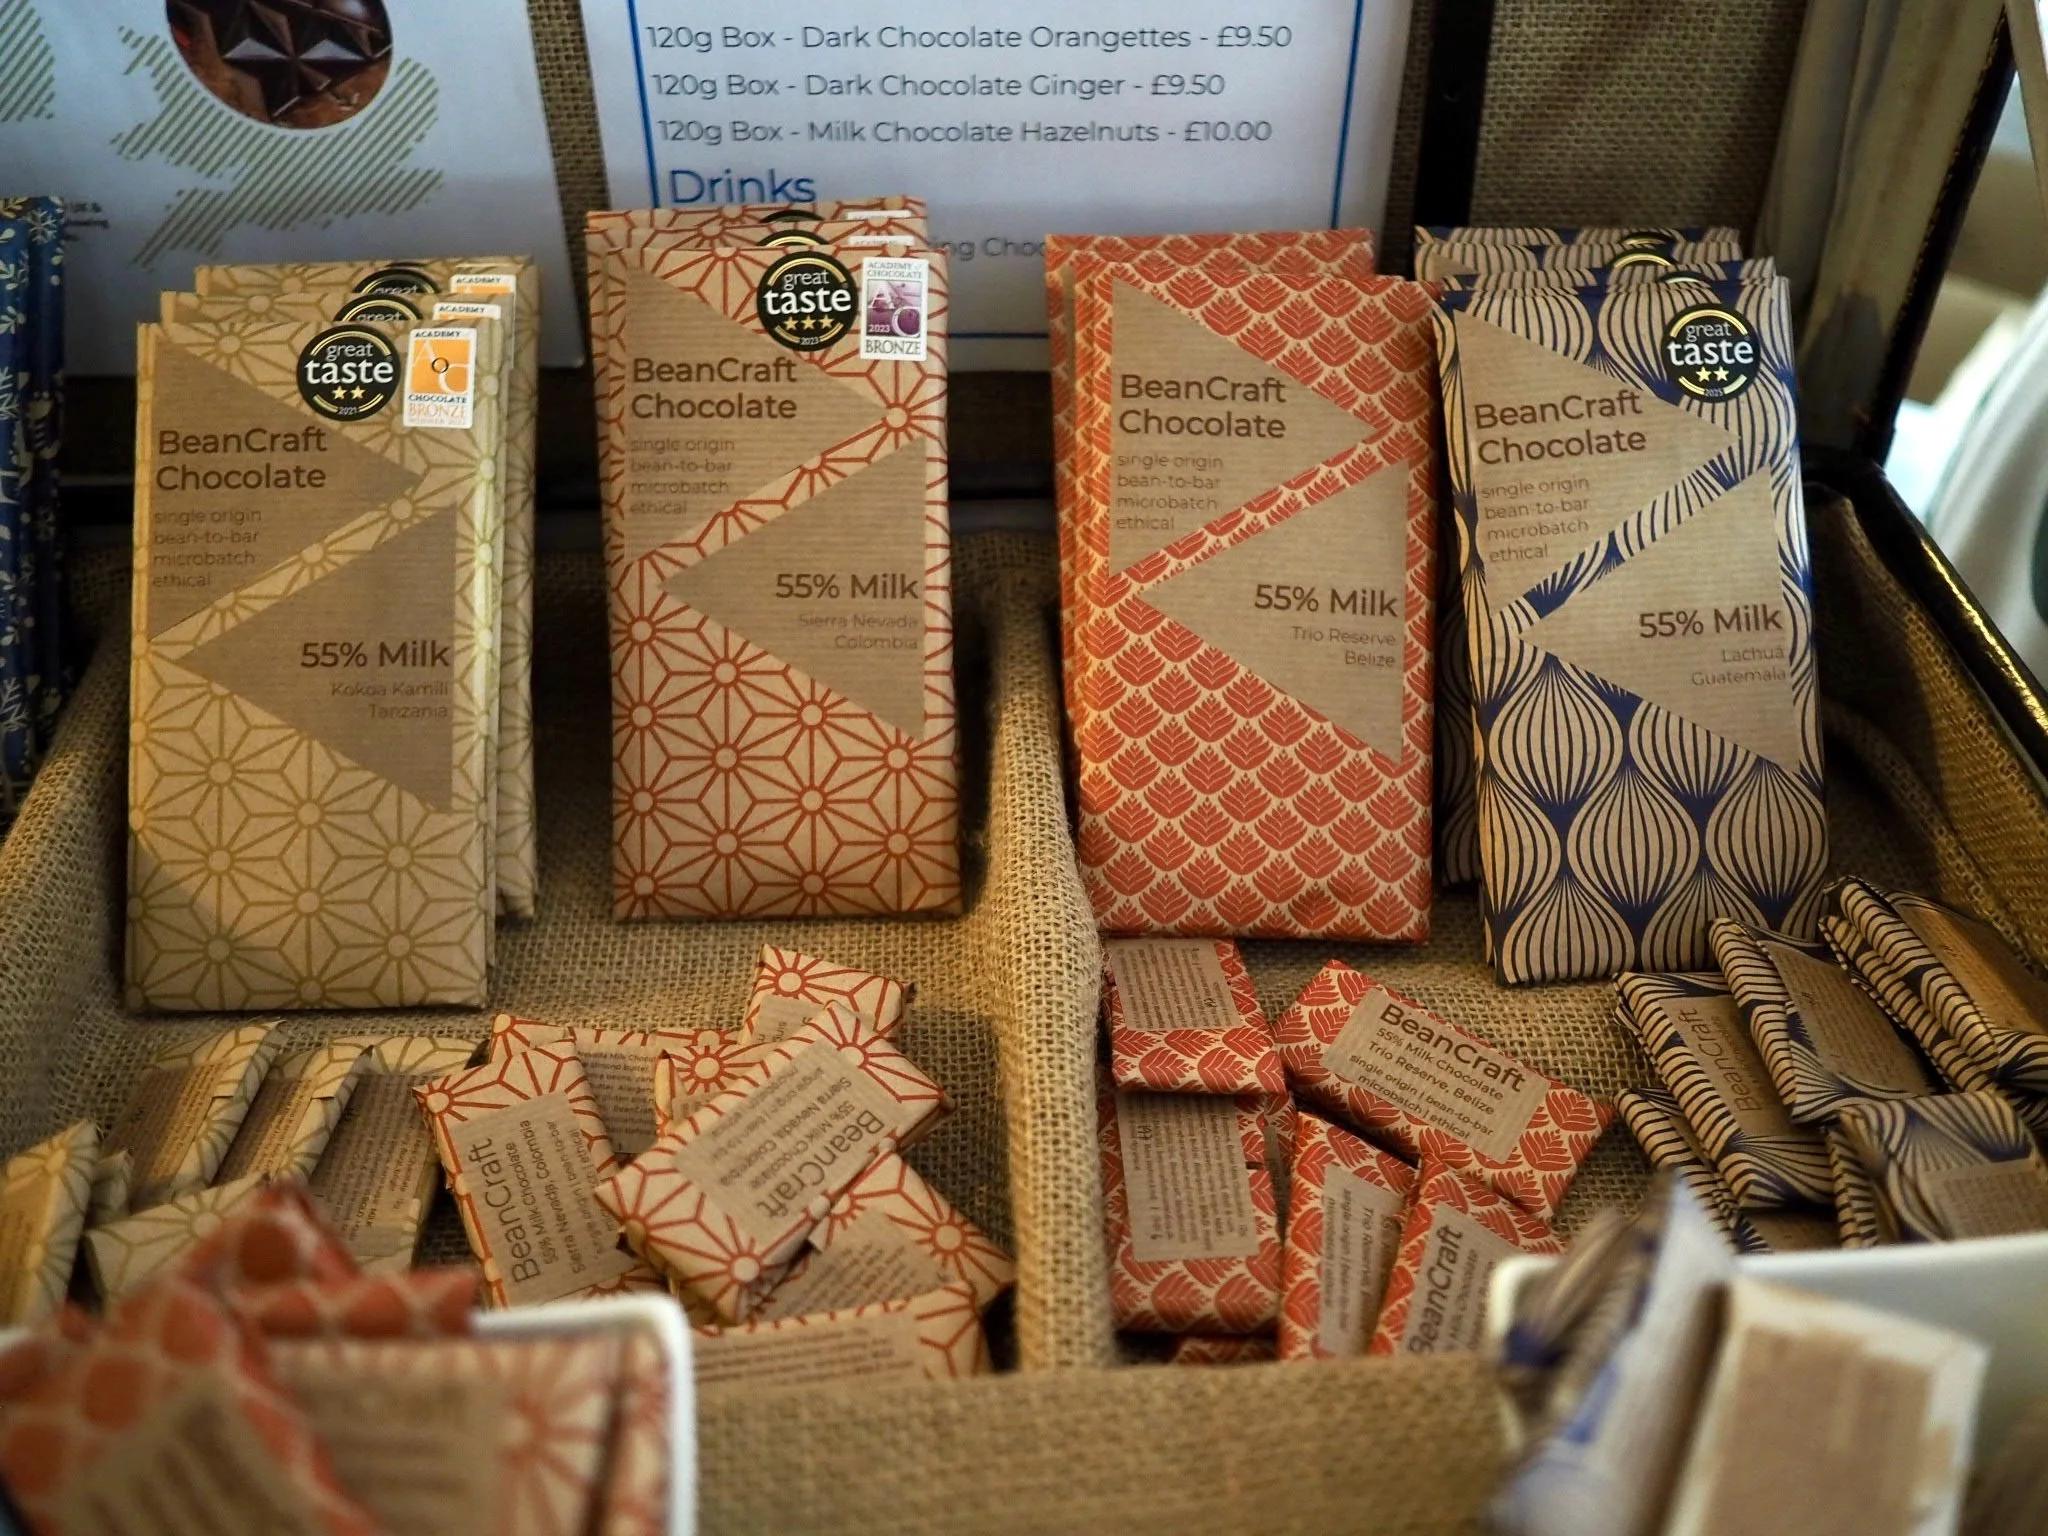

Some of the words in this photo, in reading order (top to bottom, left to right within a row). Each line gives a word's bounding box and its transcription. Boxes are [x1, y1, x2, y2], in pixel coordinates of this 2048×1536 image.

[646, 26, 712, 52] 120g
[722, 26, 776, 48] Box
[802, 26, 871, 48] Dark
[877, 25, 1021, 48] Chocolate
[1030, 26, 1191, 52] Orangettes
[1216, 25, 1293, 49] £9.50
[652, 74, 718, 100] 120g
[727, 74, 780, 96] Box
[806, 74, 872, 96] Dark
[879, 74, 1021, 97] Chocolate
[1029, 74, 1125, 101] Ginger
[1151, 74, 1226, 96] £9.50
[659, 120, 722, 146] 120g
[731, 120, 783, 142] Box
[808, 120, 866, 142] Milk
[872, 120, 1013, 143] Chocolate
[1021, 120, 1160, 143] Hazelnuts
[1184, 120, 1272, 142] £10.00
[669, 167, 817, 204] Drinks
[868, 262, 912, 270] ACADEMY
[784, 270, 830, 291] great
[763, 288, 851, 315] taste
[414, 330, 461, 339] ACADEMY
[868, 323, 891, 333] 2023
[1686, 322, 1731, 343] great
[326, 342, 373, 359] great
[865, 339, 922, 355] BRONZE
[1667, 339, 1753, 366] taste
[304, 357, 394, 386] taste
[632, 357, 797, 384] BeanCraft
[408, 394, 468, 404] CHOCOLATE
[1121, 374, 1287, 403] BeanCraft
[631, 392, 797, 420] Chocolate
[1475, 390, 1643, 430] BeanCraft
[1119, 409, 1286, 439] Chocolate
[157, 427, 328, 457] BeanCraft
[630, 437, 680, 454] single
[685, 437, 735, 454] origin
[1478, 429, 1647, 466] Chocolate
[630, 458, 732, 474] bean-to-bar
[1118, 453, 1169, 470] single
[1174, 454, 1224, 471] origin
[156, 463, 326, 492] Chocolate
[630, 479, 729, 495] microbatch
[1117, 474, 1221, 490] bean-to-bar
[1481, 481, 1535, 500] single
[1538, 475, 1590, 496] origin
[154, 508, 206, 526] single
[209, 508, 262, 526] origin
[630, 500, 687, 516] ethical
[1117, 496, 1217, 511] microbatch
[1484, 498, 1589, 521] bean-to-bar
[1116, 516, 1175, 531] ethical
[1487, 518, 1589, 541] microbatch
[154, 529, 258, 546] bean-to-bar
[153, 550, 256, 567] microbatch
[1489, 543, 1548, 563] ethical
[152, 572, 211, 588] ethical
[775, 573, 840, 599] 55%
[851, 573, 919, 600] Milk
[1254, 583, 1319, 612] 55%
[1331, 587, 1398, 618] Milk
[854, 613, 918, 629] Nevada
[1639, 610, 1704, 639] 55%
[1714, 604, 1783, 634] Milk
[834, 635, 918, 650] Colombia
[1292, 625, 1324, 643] Trio
[1329, 627, 1396, 647] Reserve
[300, 641, 367, 668] 55%
[378, 640, 450, 668] Milk
[1345, 650, 1396, 668] Belize
[1692, 666, 1786, 687] Guatemala
[369, 703, 448, 719] Tanzania
[1379, 1002, 1528, 1093] BeanCraft
[1677, 1006, 1760, 1115] BeanCraft
[1375, 1026, 1404, 1047] 55%
[1404, 1041, 1434, 1064] Milk
[1434, 1058, 1504, 1101] Chocolate
[815, 1075, 851, 1105] Sierra
[1367, 1040, 1394, 1061] Trio
[1394, 1056, 1452, 1093] Reserve,
[1452, 1087, 1495, 1116] Belize
[1348, 1053, 1383, 1077] single
[1383, 1072, 1418, 1097] origin
[1424, 1095, 1494, 1136] bean-to-bar
[1357, 1074, 1423, 1114] microbatch
[1428, 1113, 1470, 1139] ethical
[805, 1118, 833, 1144] Milk
[518, 1119, 550, 1179] Colombia
[568, 1128, 589, 1164] ethical
[503, 1141, 536, 1206] Chocolate
[718, 1138, 777, 1187] Colombia
[749, 1138, 809, 1190] Chocolate
[756, 1107, 885, 1222] BeanCraft
[465, 1137, 540, 1283] BeanCraft
[527, 1207, 546, 1235] Milk
[561, 1234, 585, 1274] Sierra
